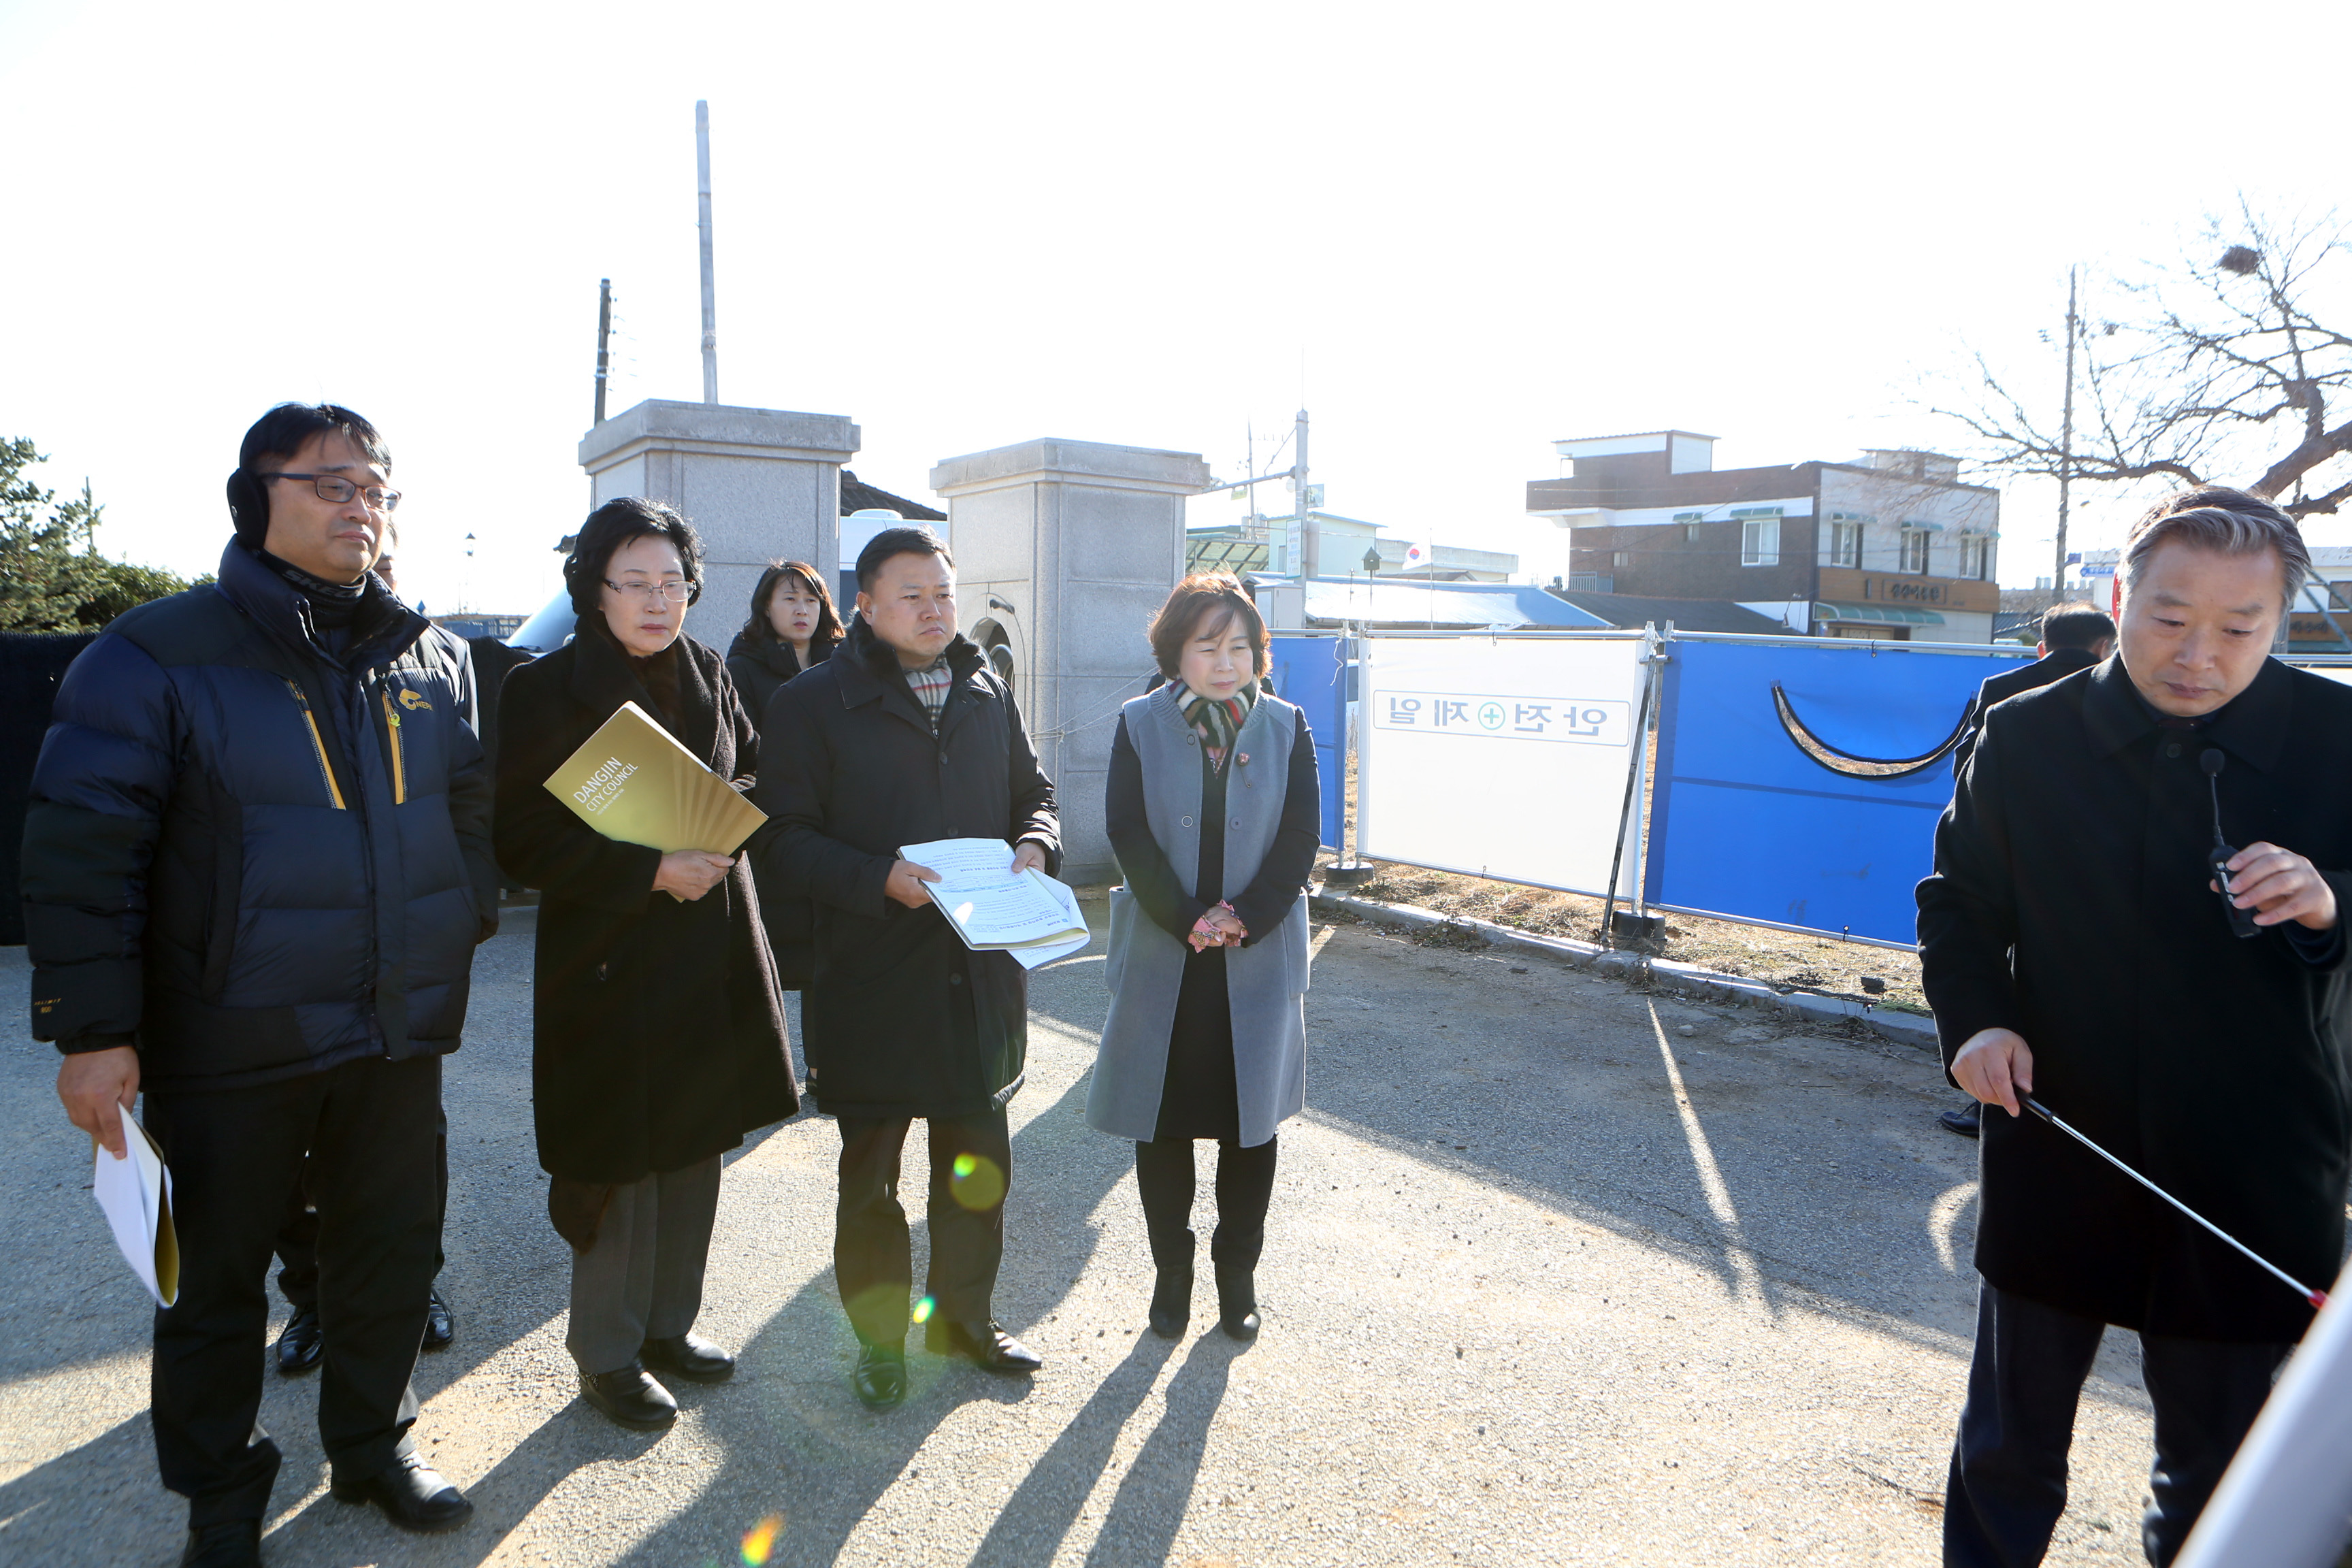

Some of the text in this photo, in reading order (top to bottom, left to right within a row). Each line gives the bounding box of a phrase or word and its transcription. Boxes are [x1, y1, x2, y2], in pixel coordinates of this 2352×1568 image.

[283, 570, 361, 598] SKEC
[573, 756, 622, 804] DANGJIN
[585, 791, 606, 812] CITY
[602, 763, 638, 796] COUNCIL
